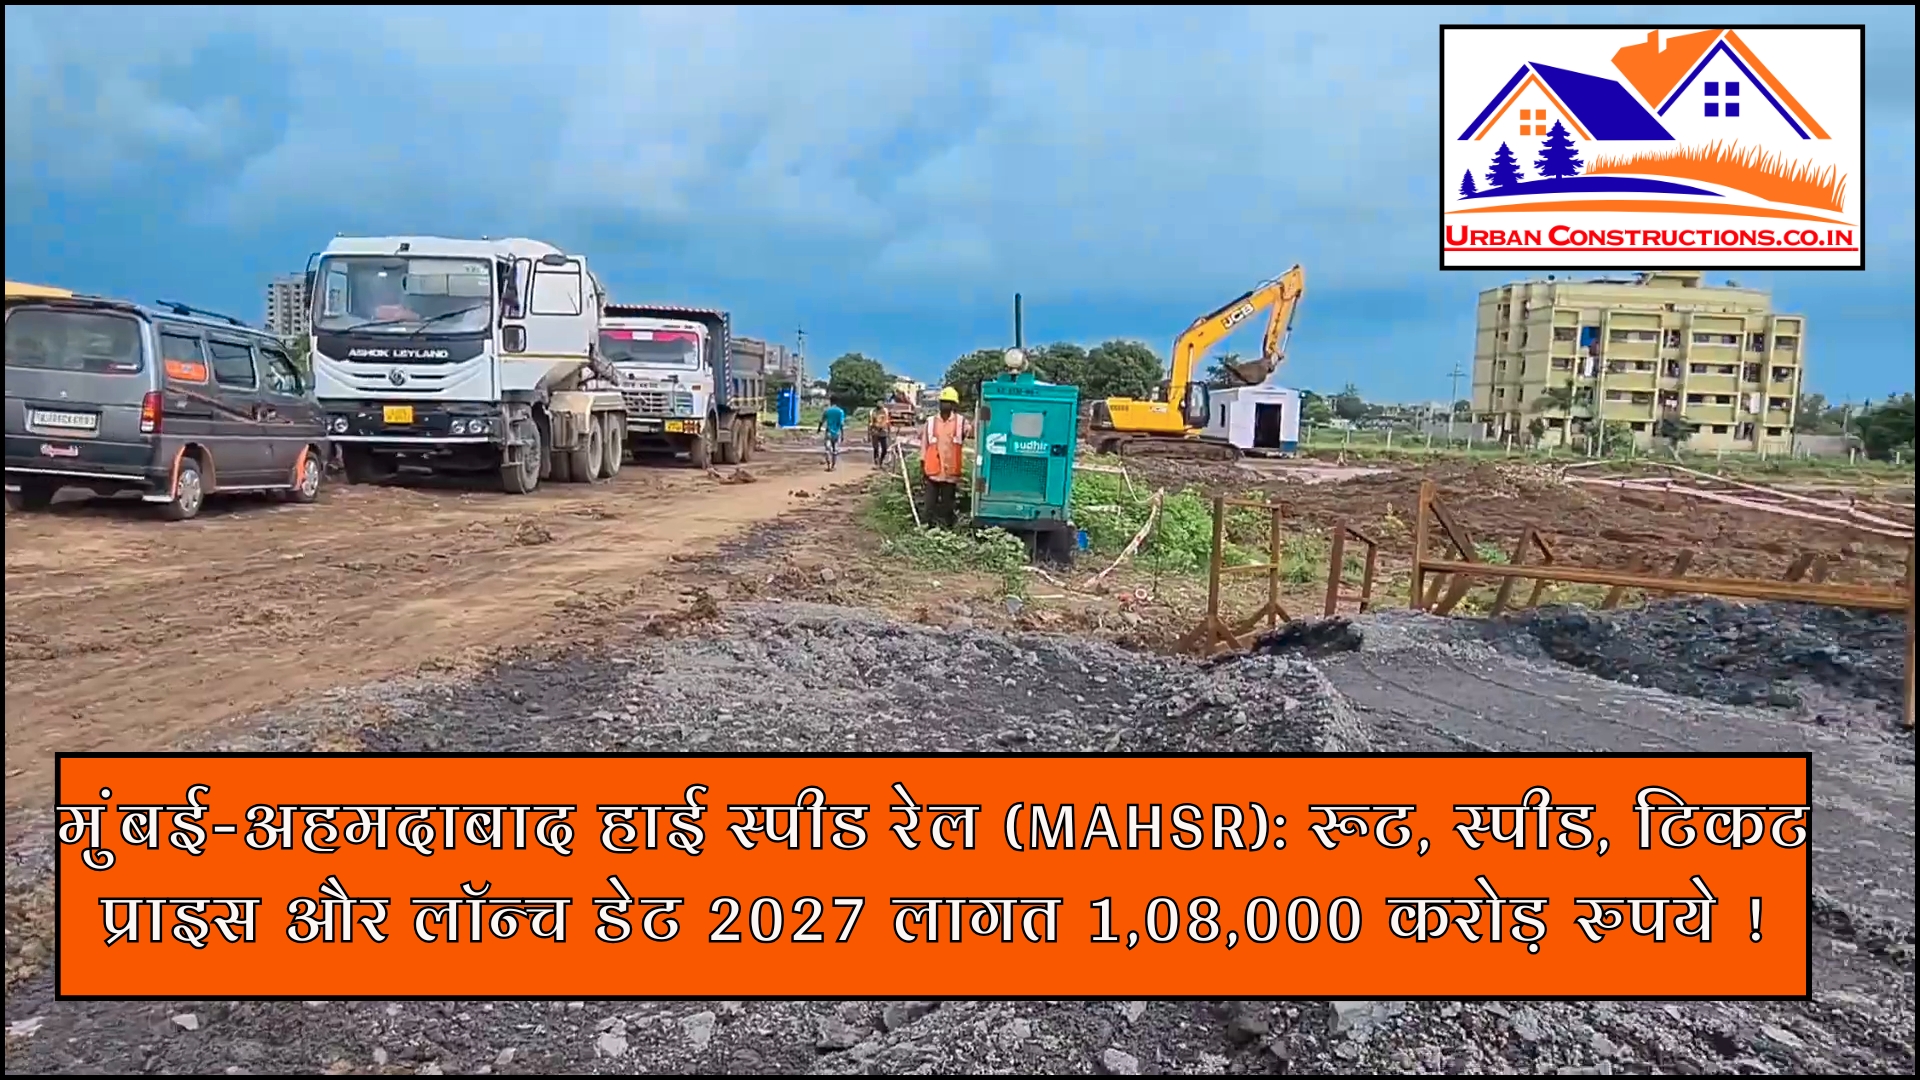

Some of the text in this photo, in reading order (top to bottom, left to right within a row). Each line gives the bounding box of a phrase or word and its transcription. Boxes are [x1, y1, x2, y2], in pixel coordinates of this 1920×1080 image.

[1223, 303, 1254, 329] JCB
[348, 348, 449, 359] ASHOK LEYLAND
[1014, 440, 1048, 452] sudhir
